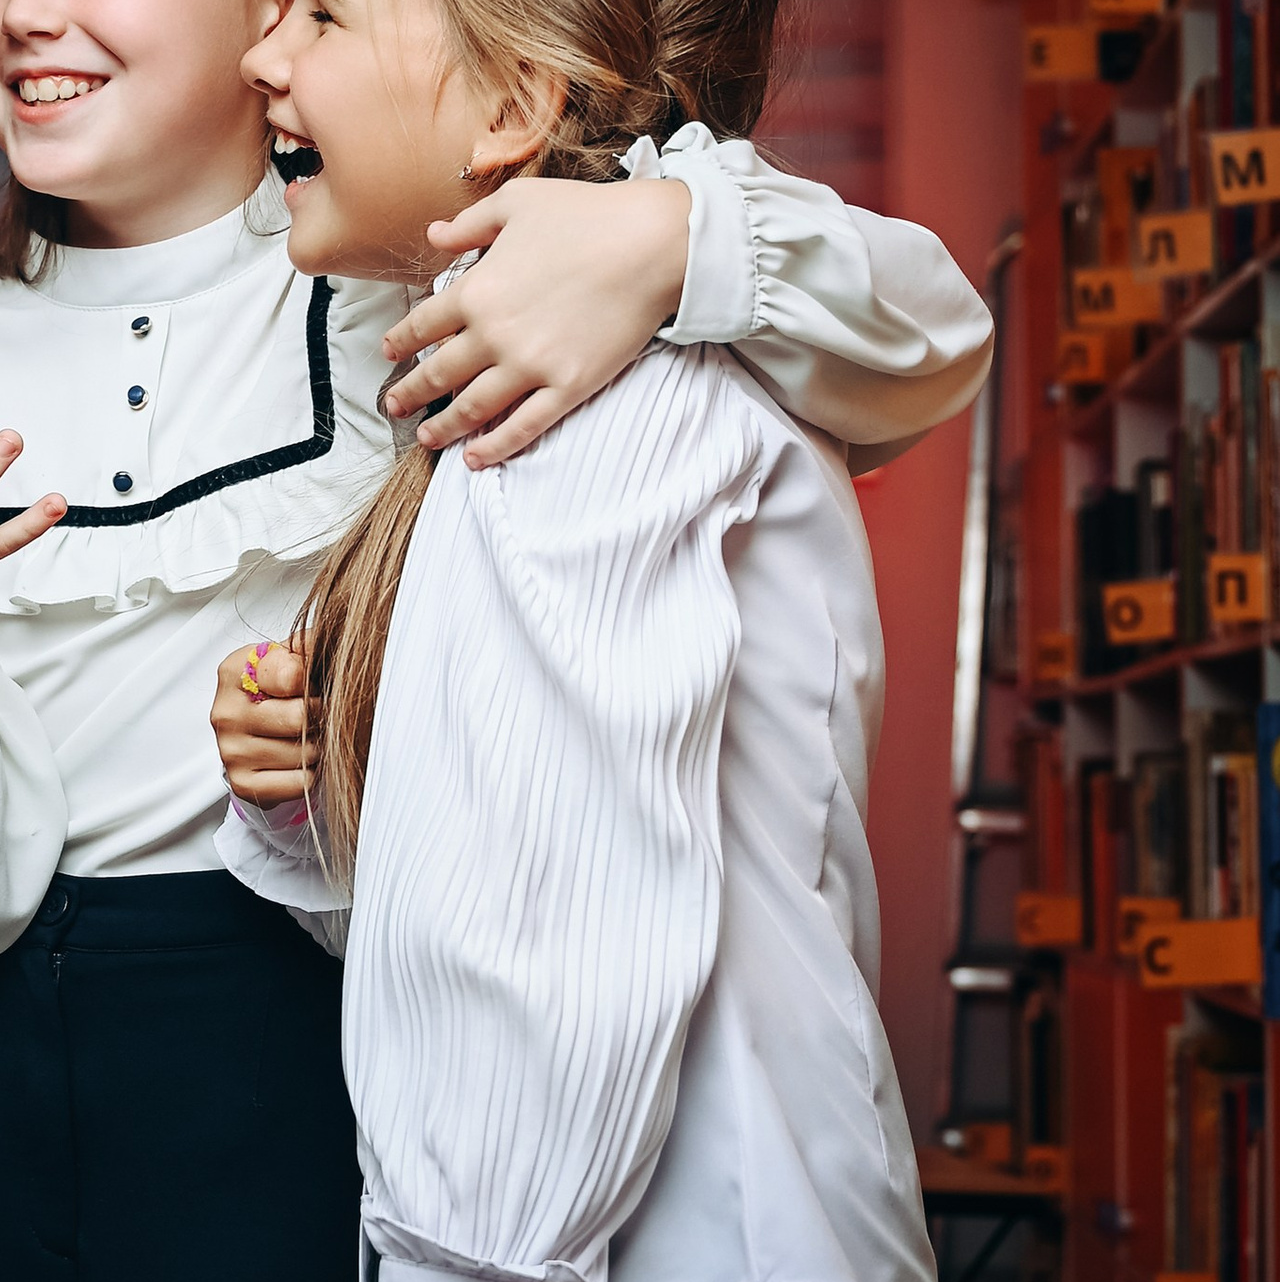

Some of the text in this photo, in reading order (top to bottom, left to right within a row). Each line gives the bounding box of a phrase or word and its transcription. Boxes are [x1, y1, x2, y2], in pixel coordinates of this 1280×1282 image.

[1220, 148, 1265, 189] М
[1147, 228, 1176, 265] Л
[1079, 282, 1114, 312] М
[1216, 569, 1248, 606] П
[1108, 596, 1143, 632] О
[1145, 936, 1172, 975] С
